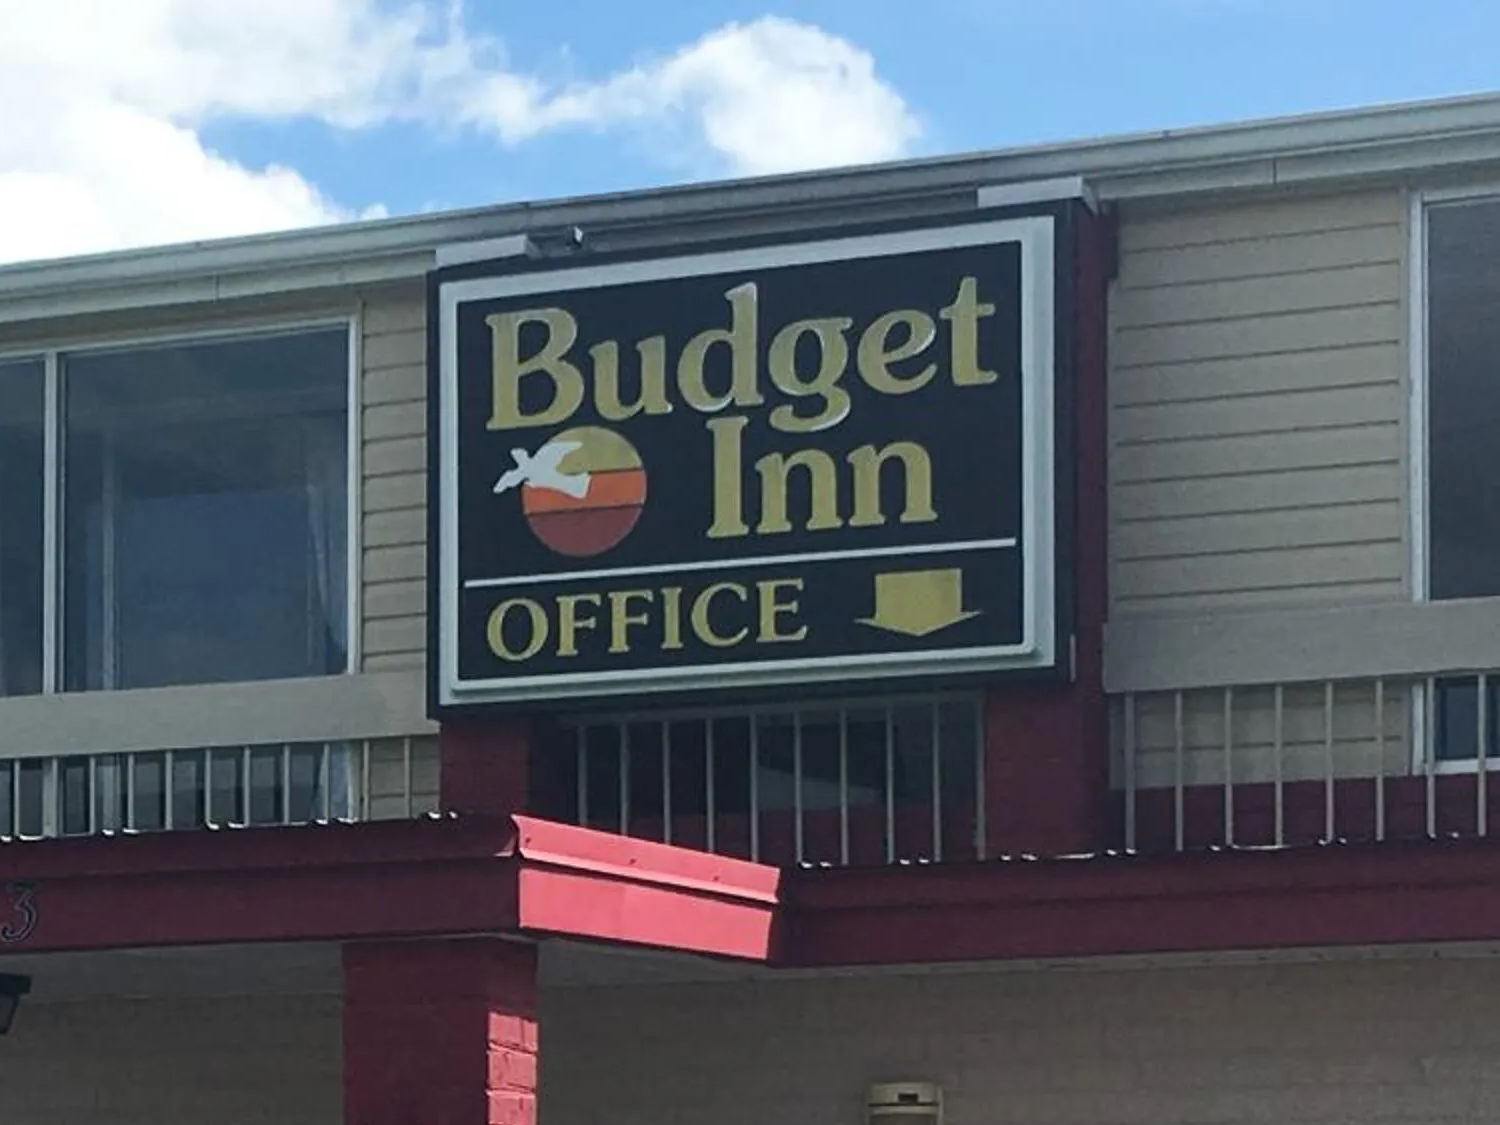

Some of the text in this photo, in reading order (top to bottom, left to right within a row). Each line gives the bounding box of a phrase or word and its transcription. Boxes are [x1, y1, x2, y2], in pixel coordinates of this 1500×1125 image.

[486, 276, 998, 433] Budget
[705, 415, 938, 539] Inn
[486, 577, 808, 661] OFFICE
